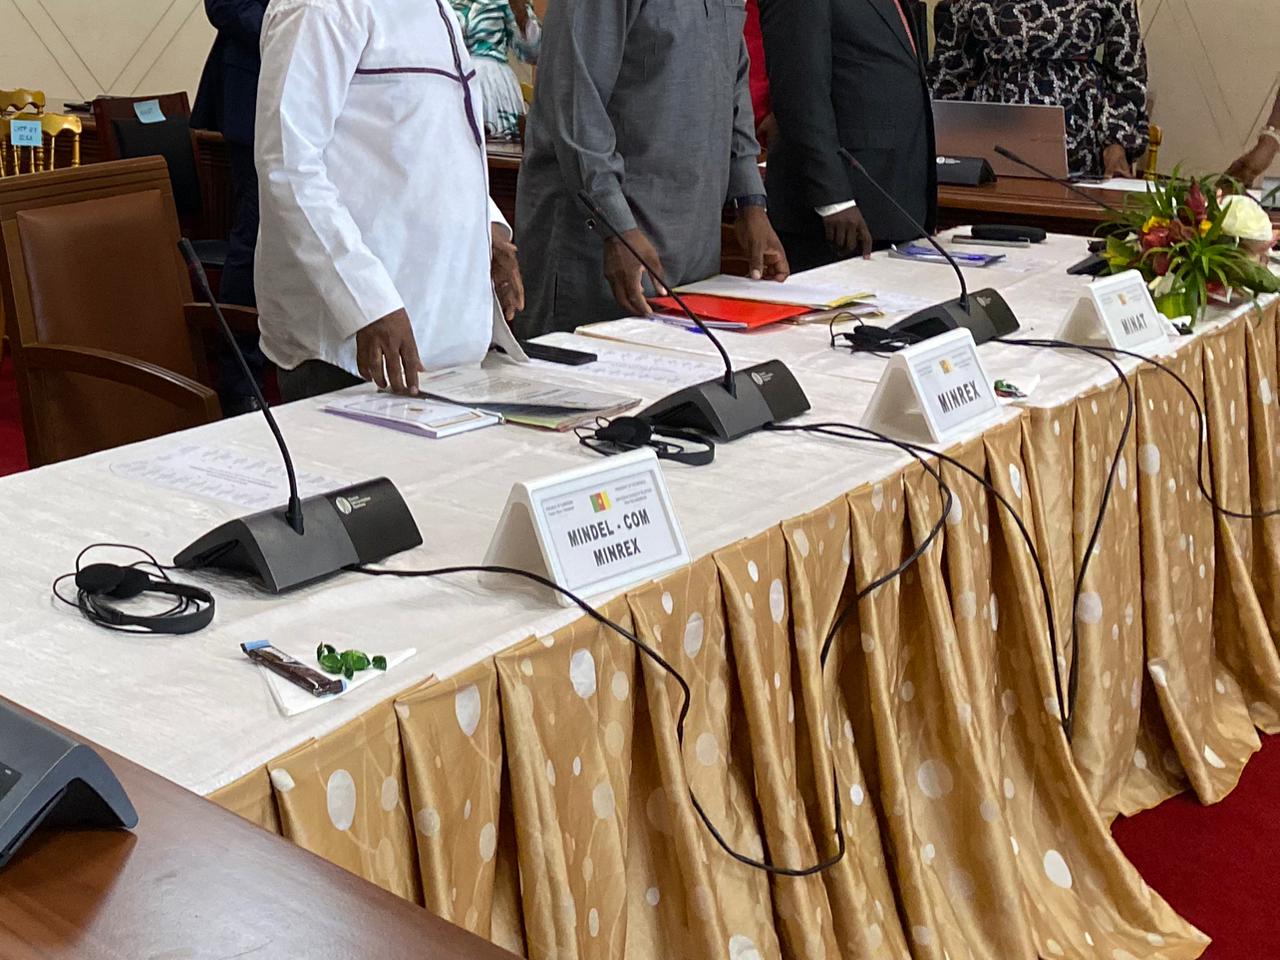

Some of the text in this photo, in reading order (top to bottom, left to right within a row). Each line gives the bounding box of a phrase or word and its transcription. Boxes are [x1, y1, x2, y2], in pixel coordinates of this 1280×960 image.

[937, 380, 981, 414] MINREX
[567, 519, 614, 548] MINDEL
[623, 508, 650, 530] COM
[593, 537, 641, 567] MINREX
